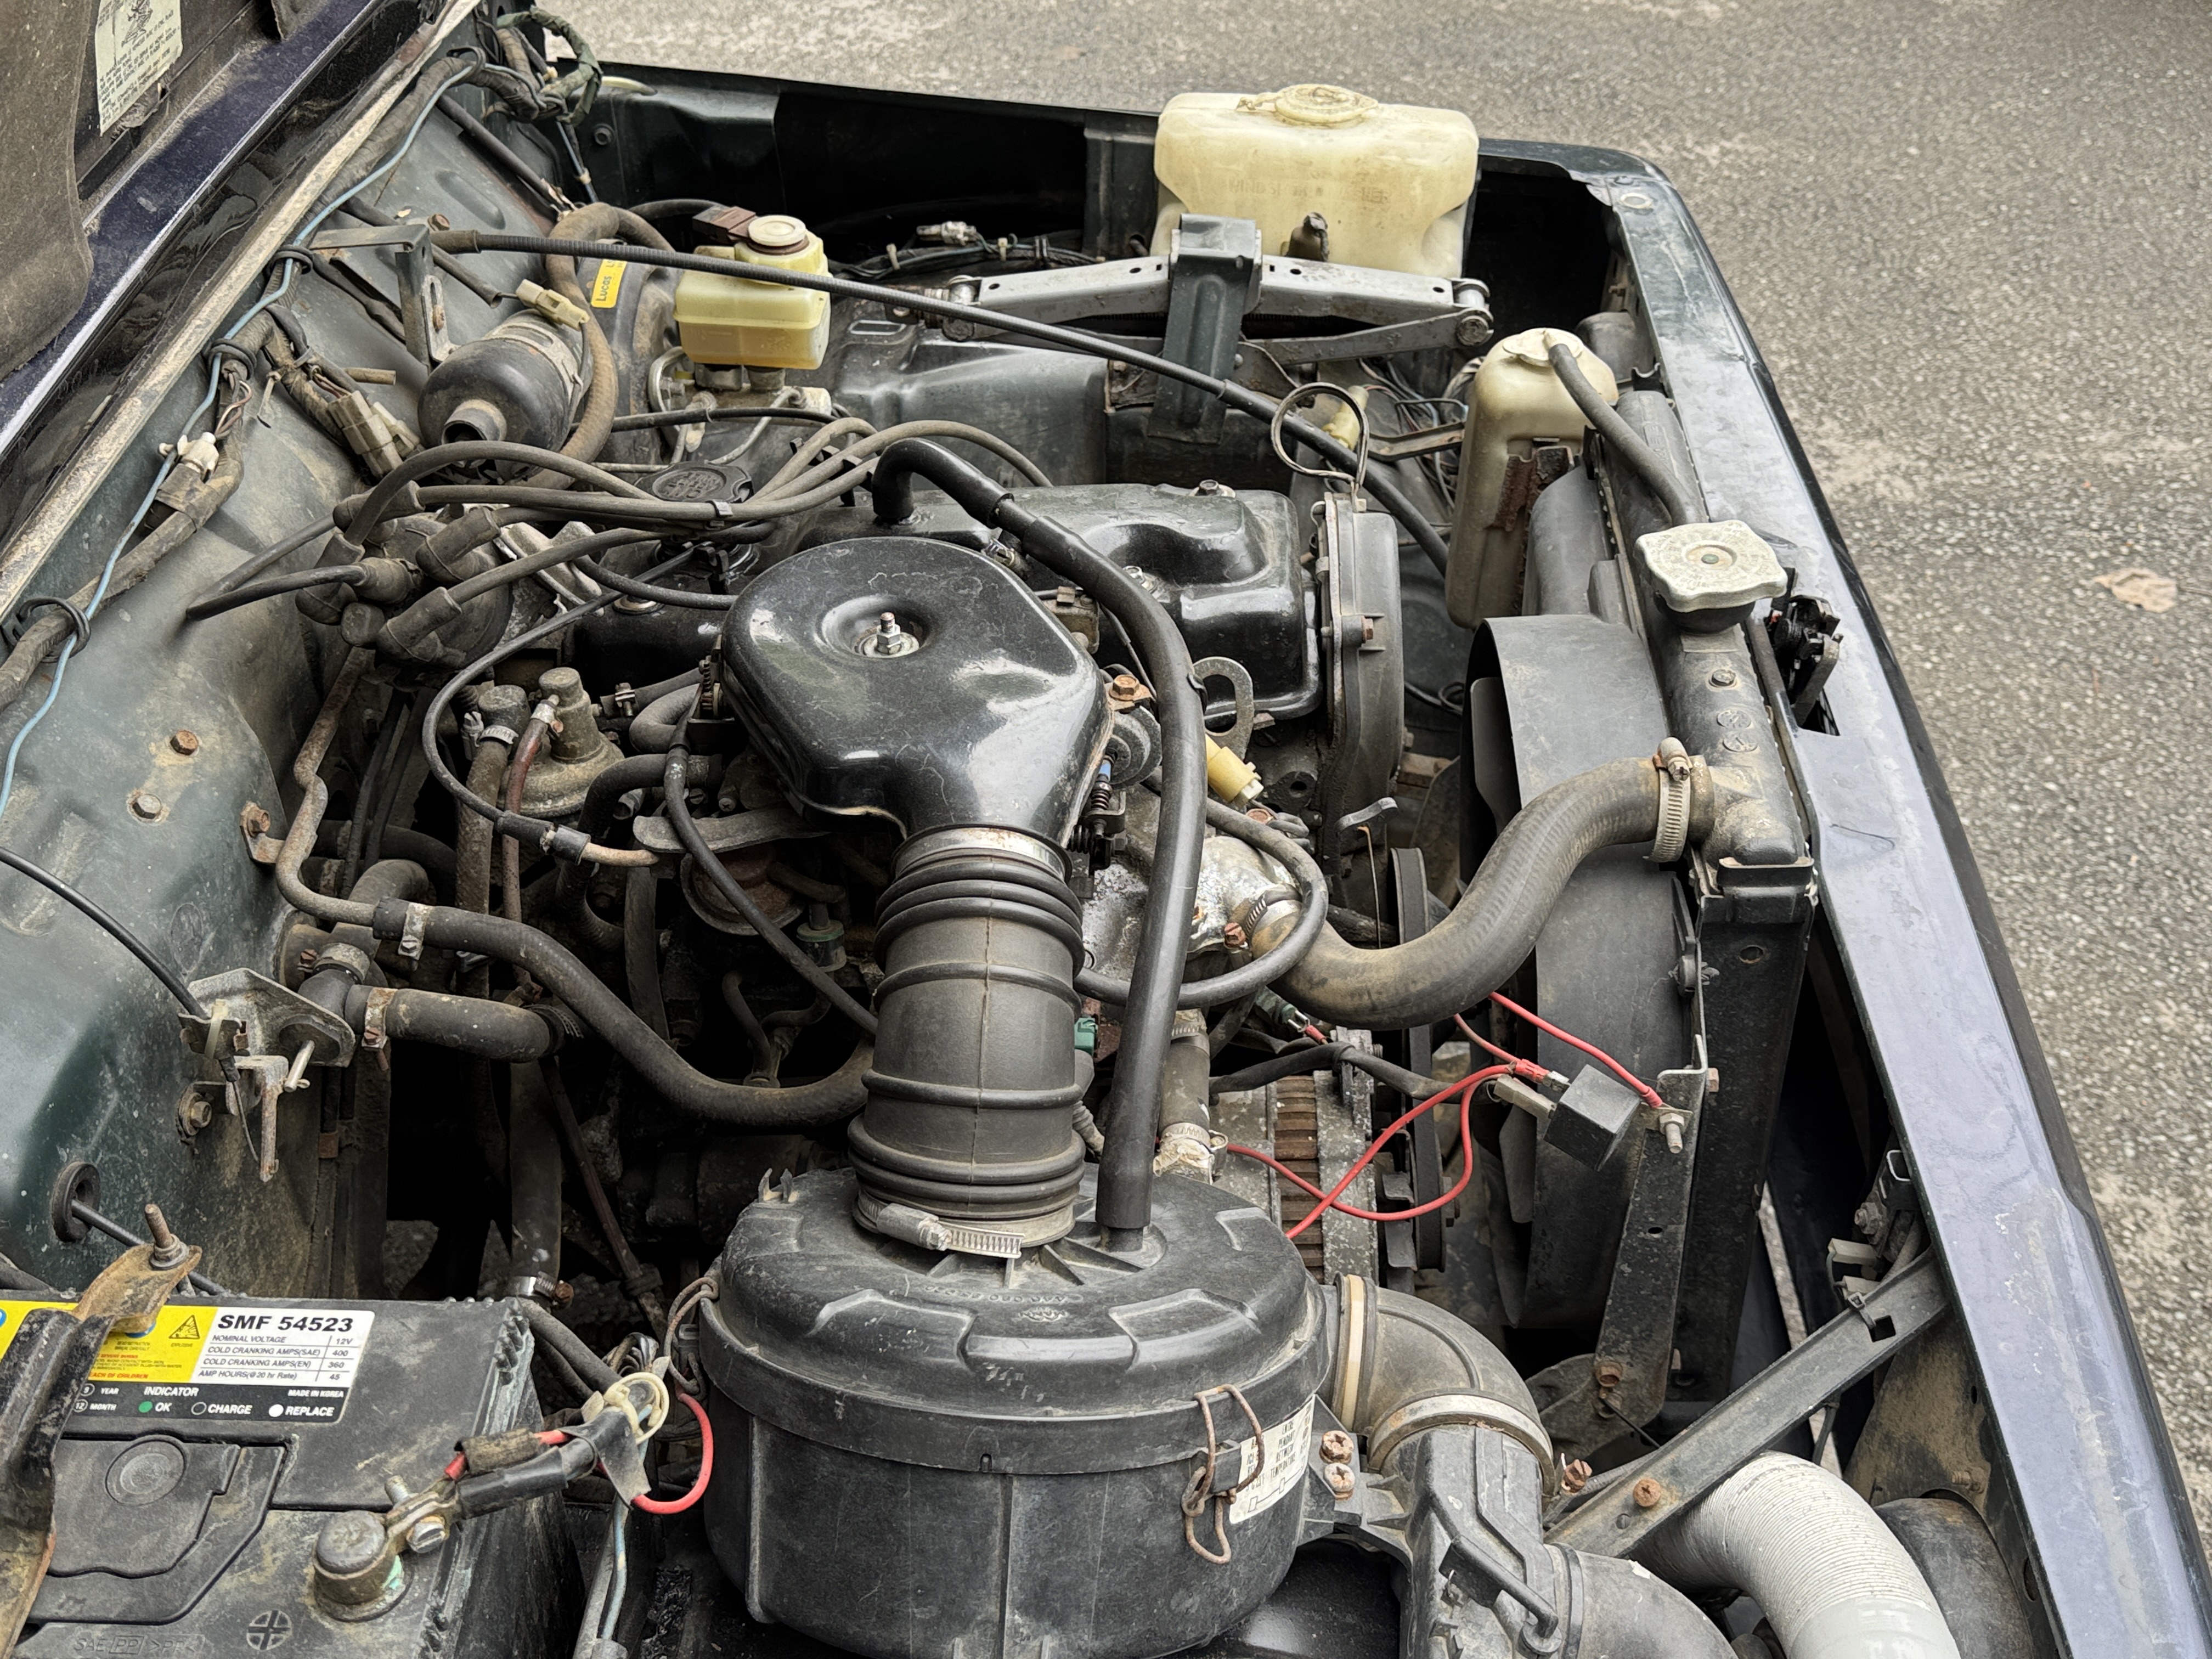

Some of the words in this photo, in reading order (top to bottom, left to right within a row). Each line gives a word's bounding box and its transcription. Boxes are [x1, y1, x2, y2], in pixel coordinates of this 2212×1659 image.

[218, 1314, 272, 1329] SMF
[278, 1317, 353, 1332] 54523
[276, 1348, 320, 1357] AMPS(SAE)
[144, 1386, 199, 1397] INDICATOR
[155, 1402, 172, 1412] OK
[207, 1404, 253, 1414] CHARGE
[285, 1406, 335, 1417] REPLACE
